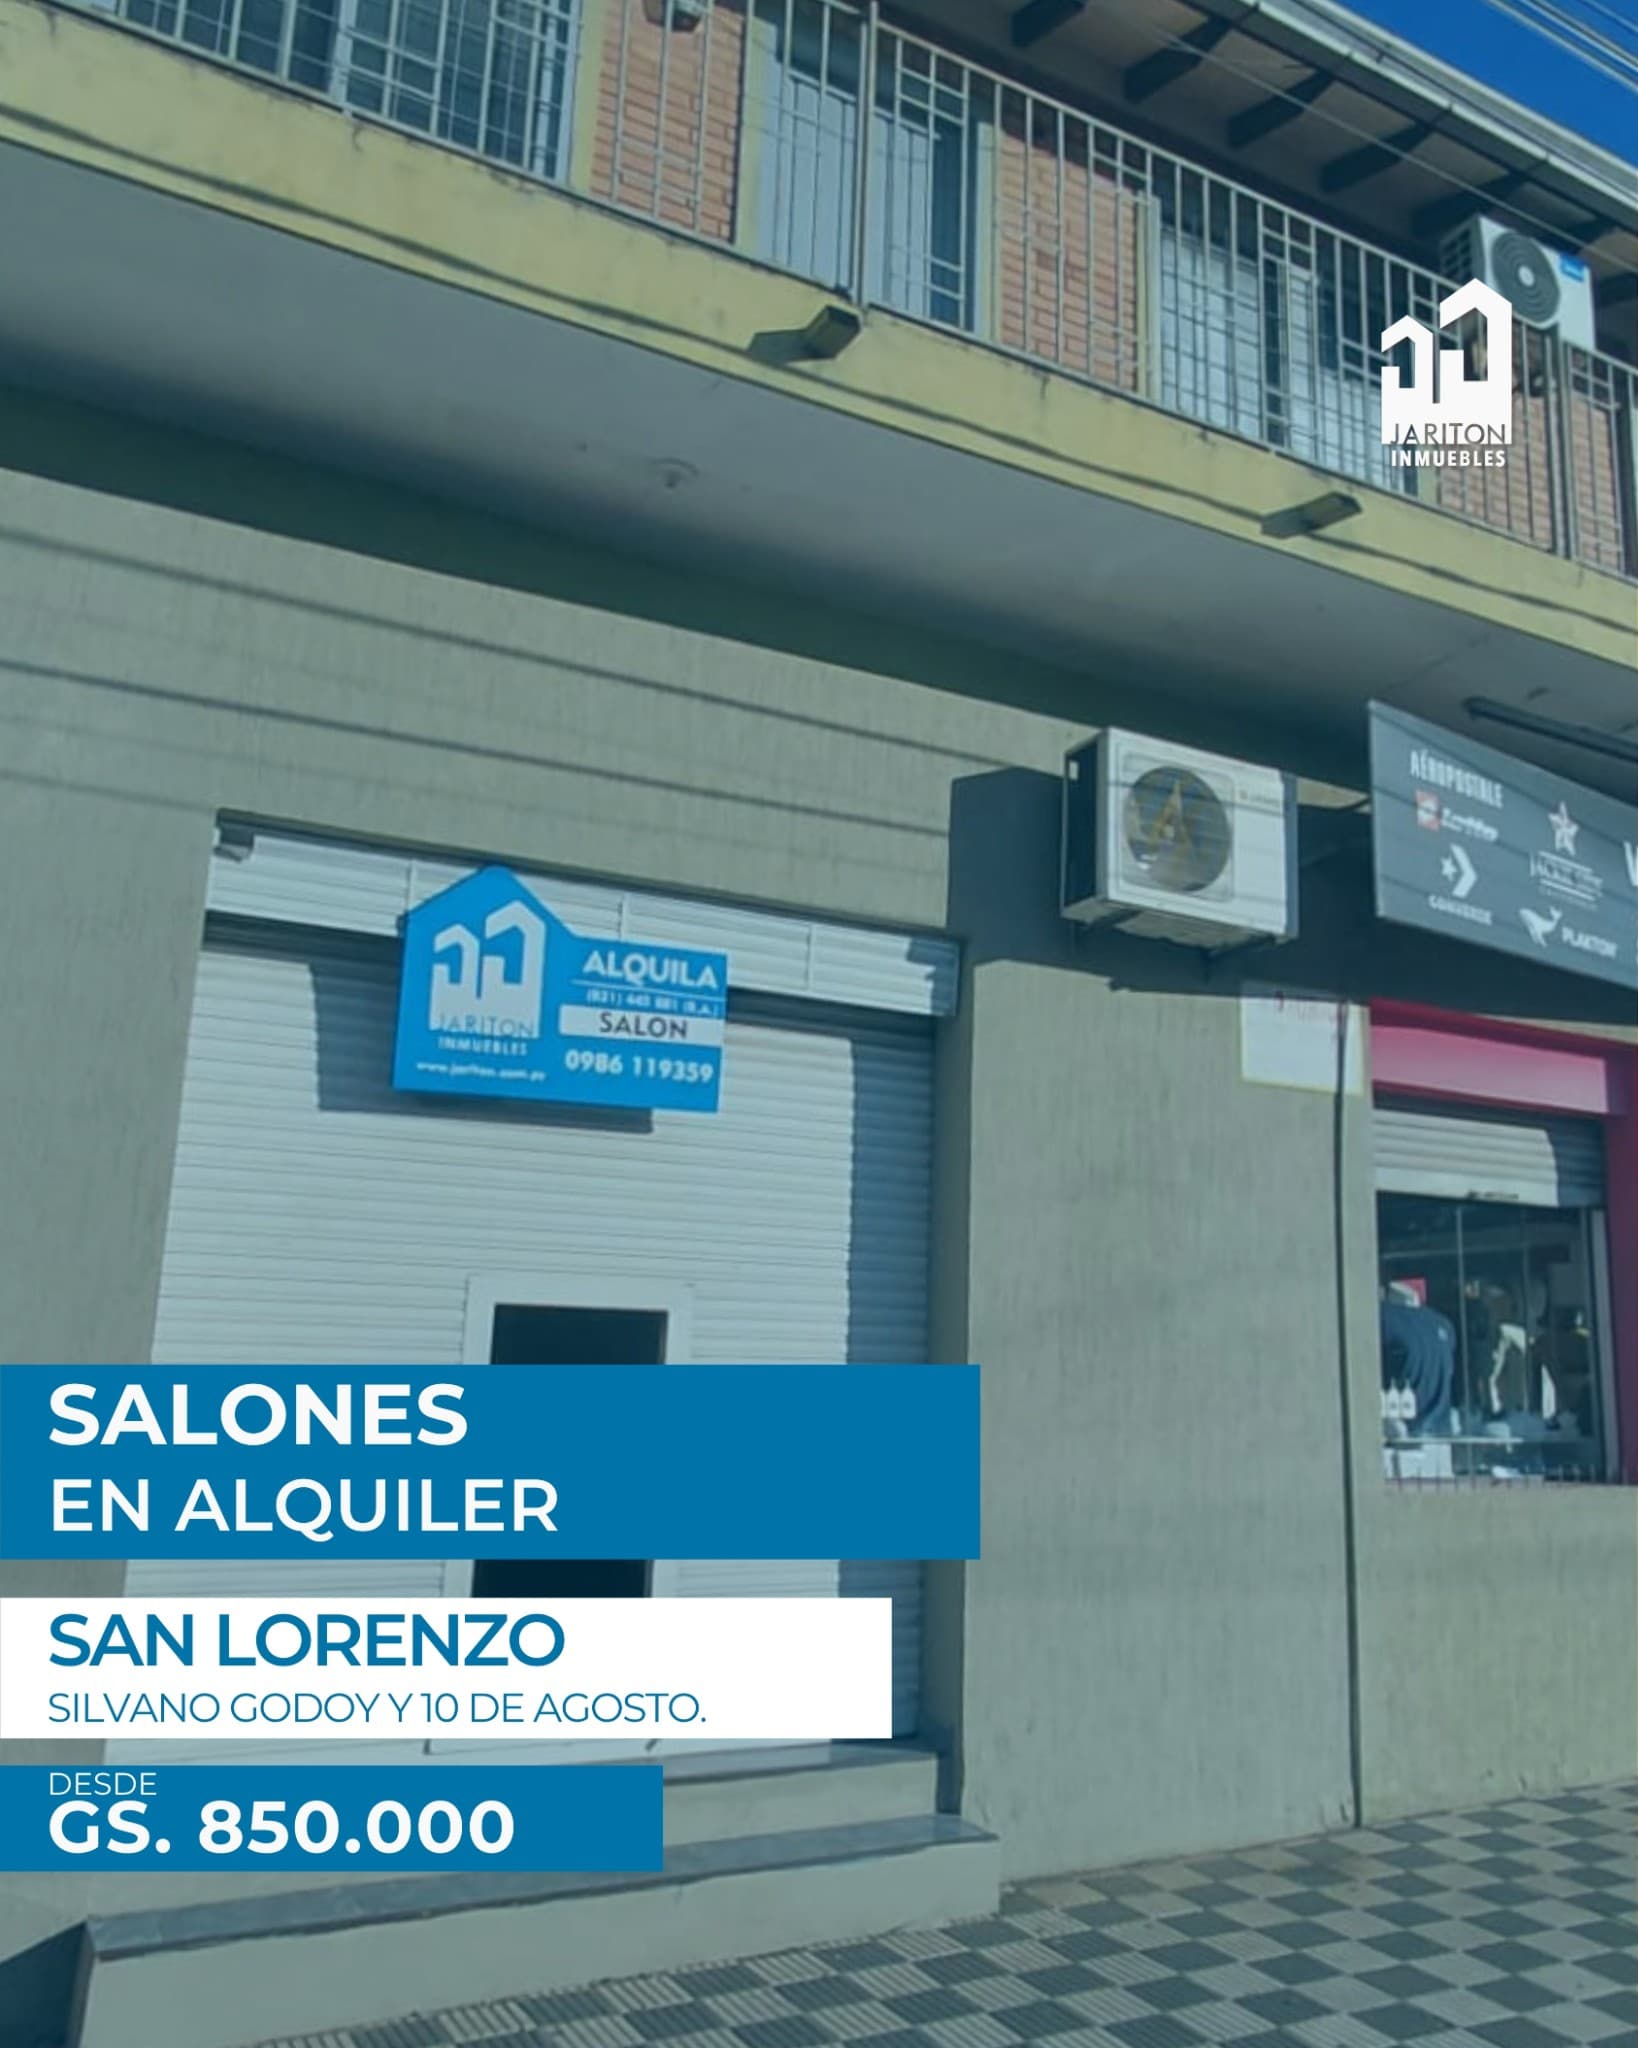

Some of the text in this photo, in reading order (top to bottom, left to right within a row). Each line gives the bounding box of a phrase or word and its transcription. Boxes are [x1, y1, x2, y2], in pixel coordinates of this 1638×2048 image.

[582, 949, 718, 989] ALQUILA
[439, 1012, 535, 1038] JARITON
[599, 1011, 688, 1039] SALON
[437, 1035, 529, 1057] INMUEBLES
[564, 1048, 714, 1083] 0986 119359
